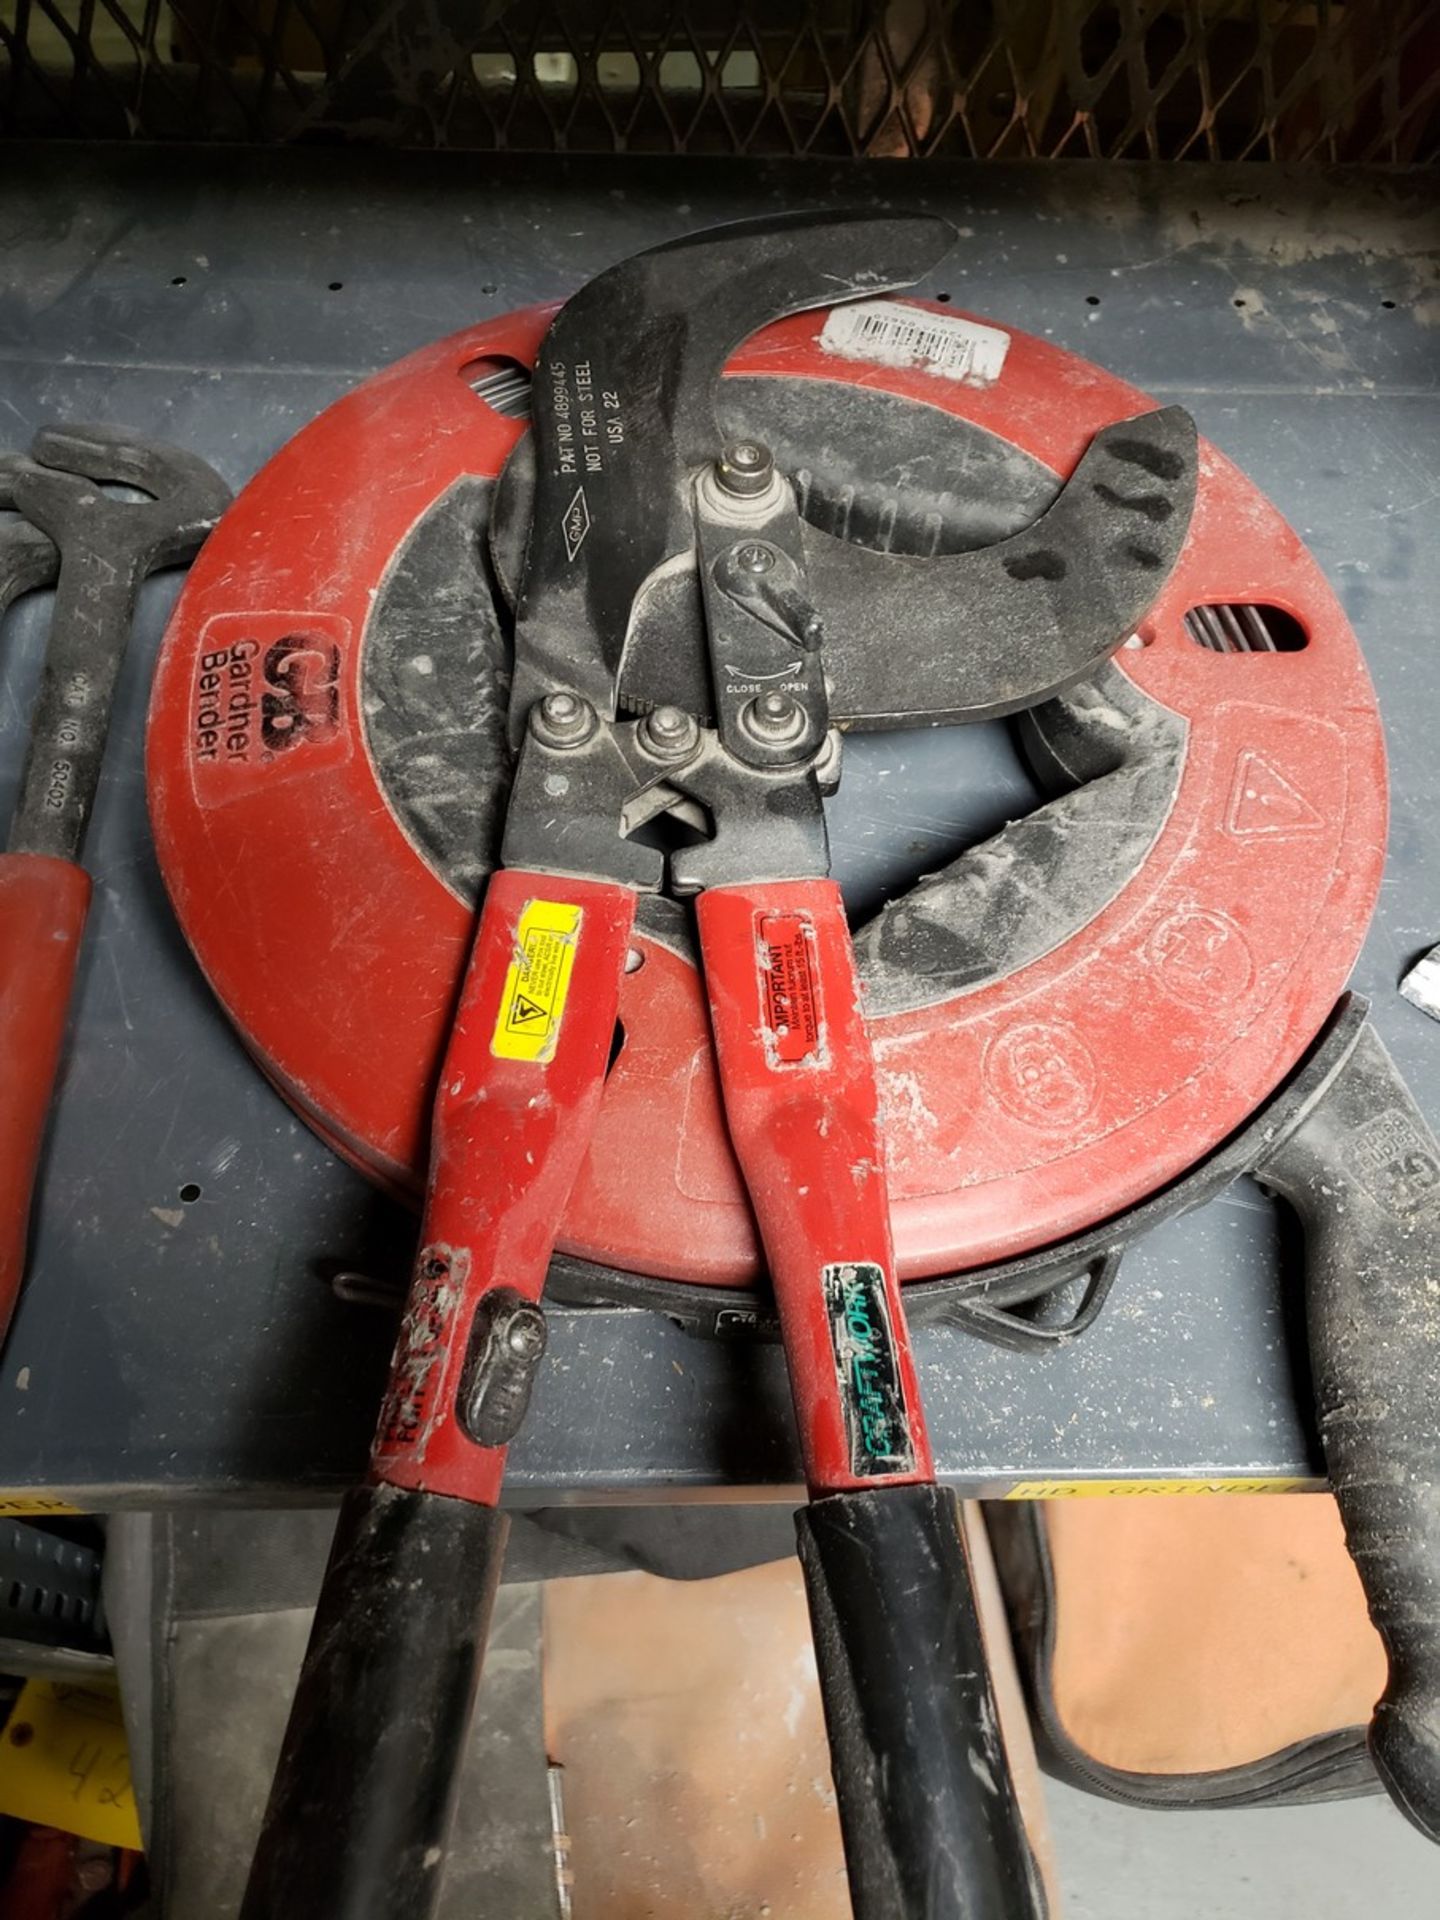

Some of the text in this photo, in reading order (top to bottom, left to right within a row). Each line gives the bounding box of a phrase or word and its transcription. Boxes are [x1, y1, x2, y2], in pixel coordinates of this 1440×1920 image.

[551, 361, 577, 473] PAT NO 4899445
[575, 360, 602, 472] NOT FOR STEEL
[602, 391, 624, 444] USA 22
[569, 507, 582, 542] GMP
[197, 651, 228, 760] Bender
[226, 639, 260, 762] Gardner
[726, 682, 809, 693] CLOSE OPEN
[46, 760, 71, 809] 50402
[768, 944, 789, 1028] MPORTANT
